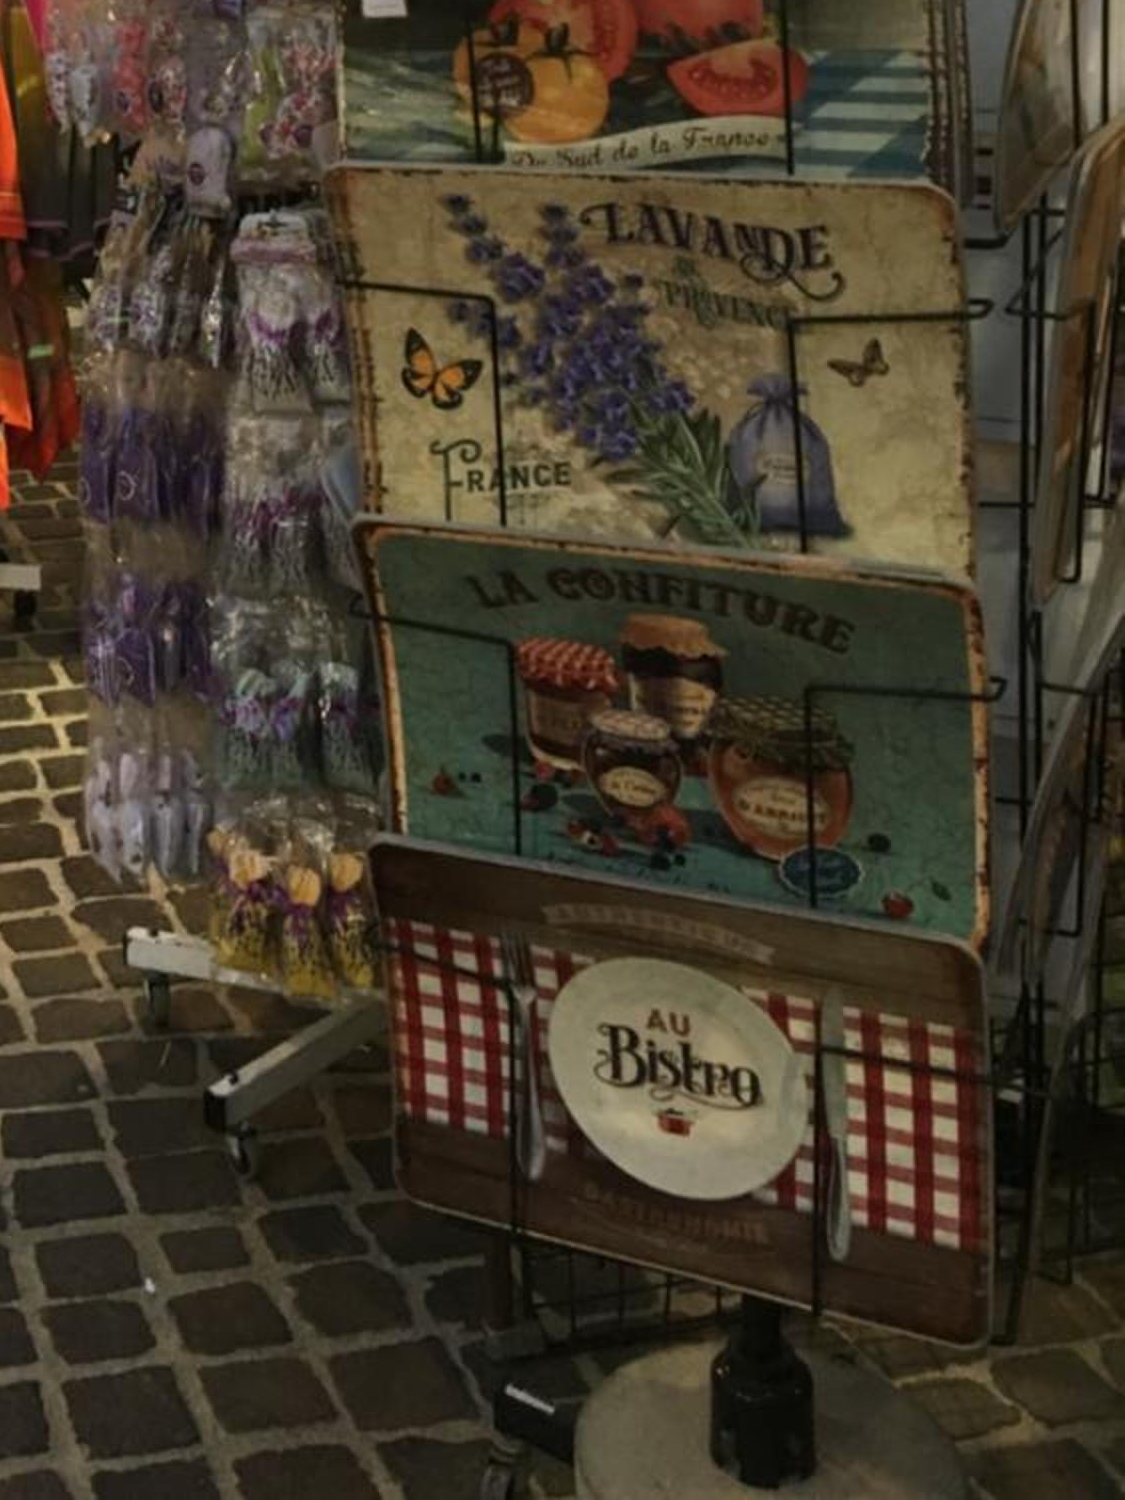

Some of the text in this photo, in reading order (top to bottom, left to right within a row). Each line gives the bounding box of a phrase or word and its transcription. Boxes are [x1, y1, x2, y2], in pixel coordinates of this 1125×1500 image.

[612, 140, 638, 161] de
[650, 133, 671, 155] la
[682, 126, 770, 149] France
[580, 202, 846, 301] LAVANDE
[465, 568, 857, 655] LA CONFITURE
[645, 1009, 691, 1037] AU
[593, 1024, 765, 1110] Bistro
